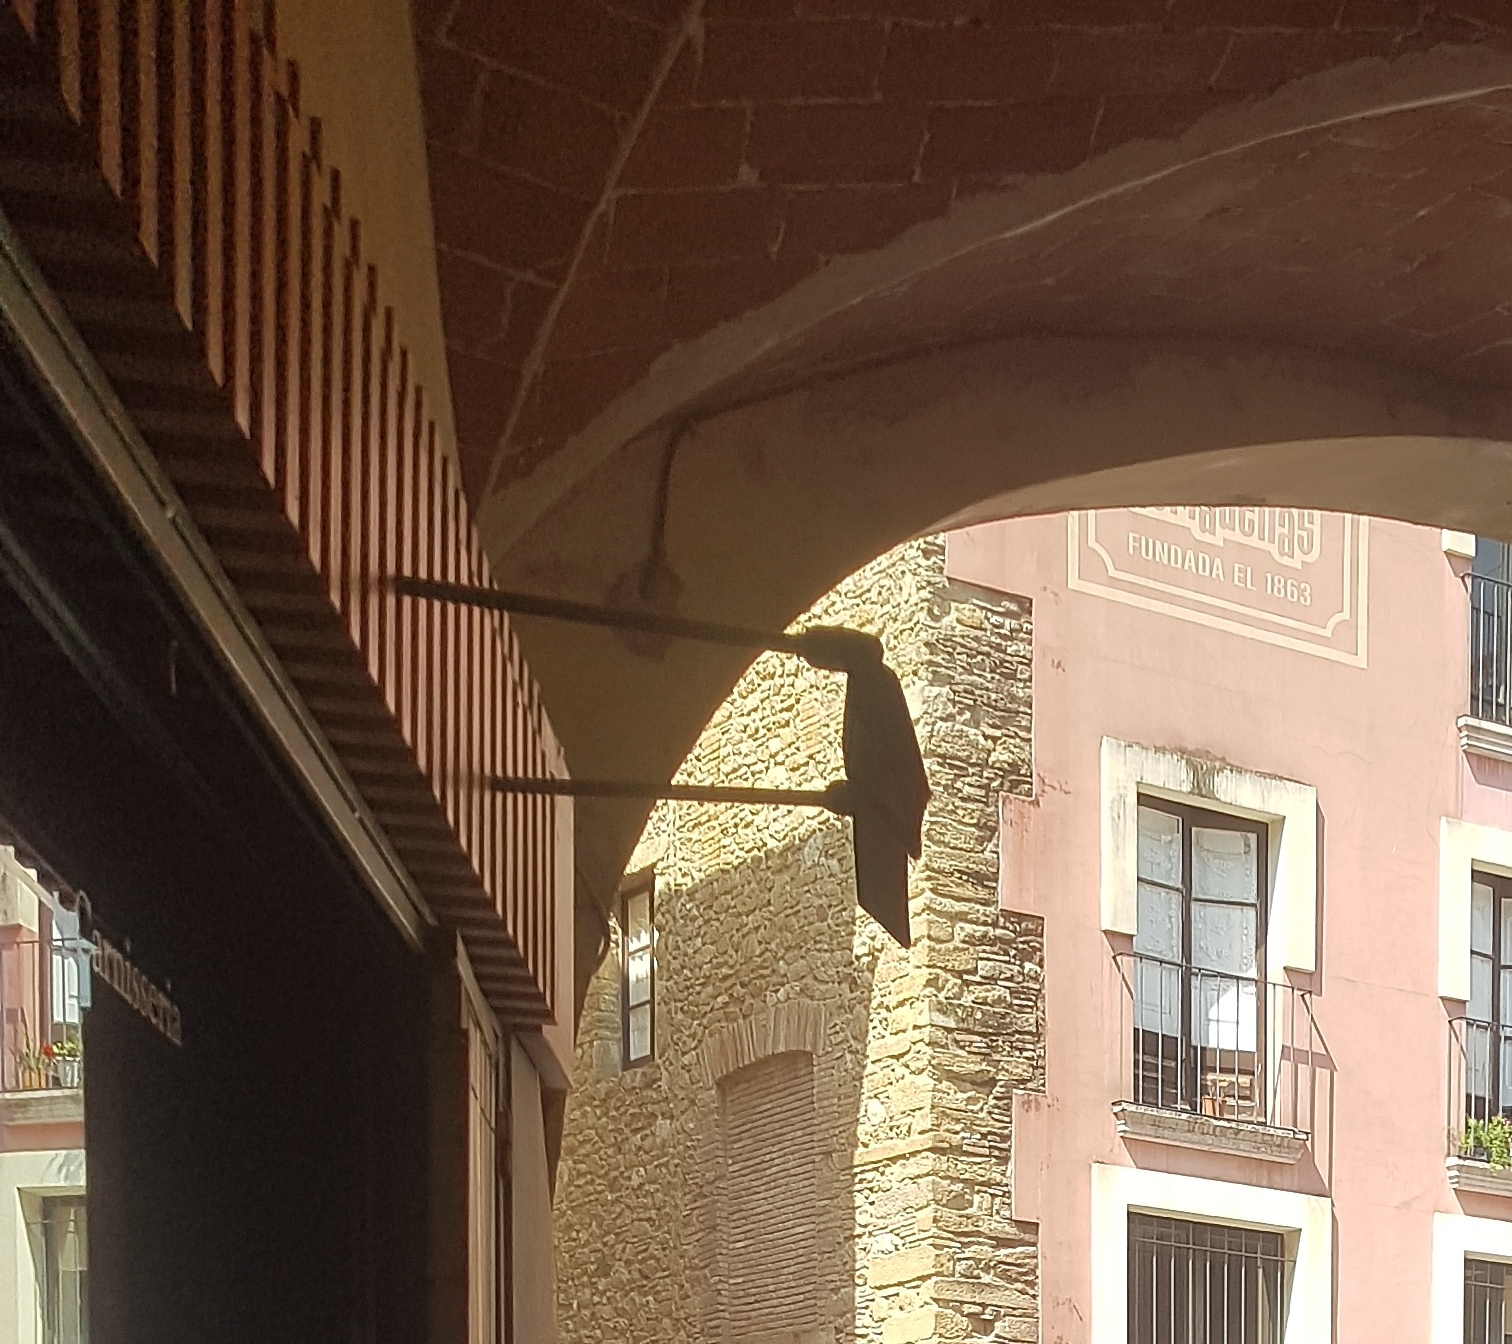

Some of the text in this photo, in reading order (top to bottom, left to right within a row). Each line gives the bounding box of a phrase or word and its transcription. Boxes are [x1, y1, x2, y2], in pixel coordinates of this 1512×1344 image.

[1127, 531, 1313, 607] FUNDADA EL 1863
